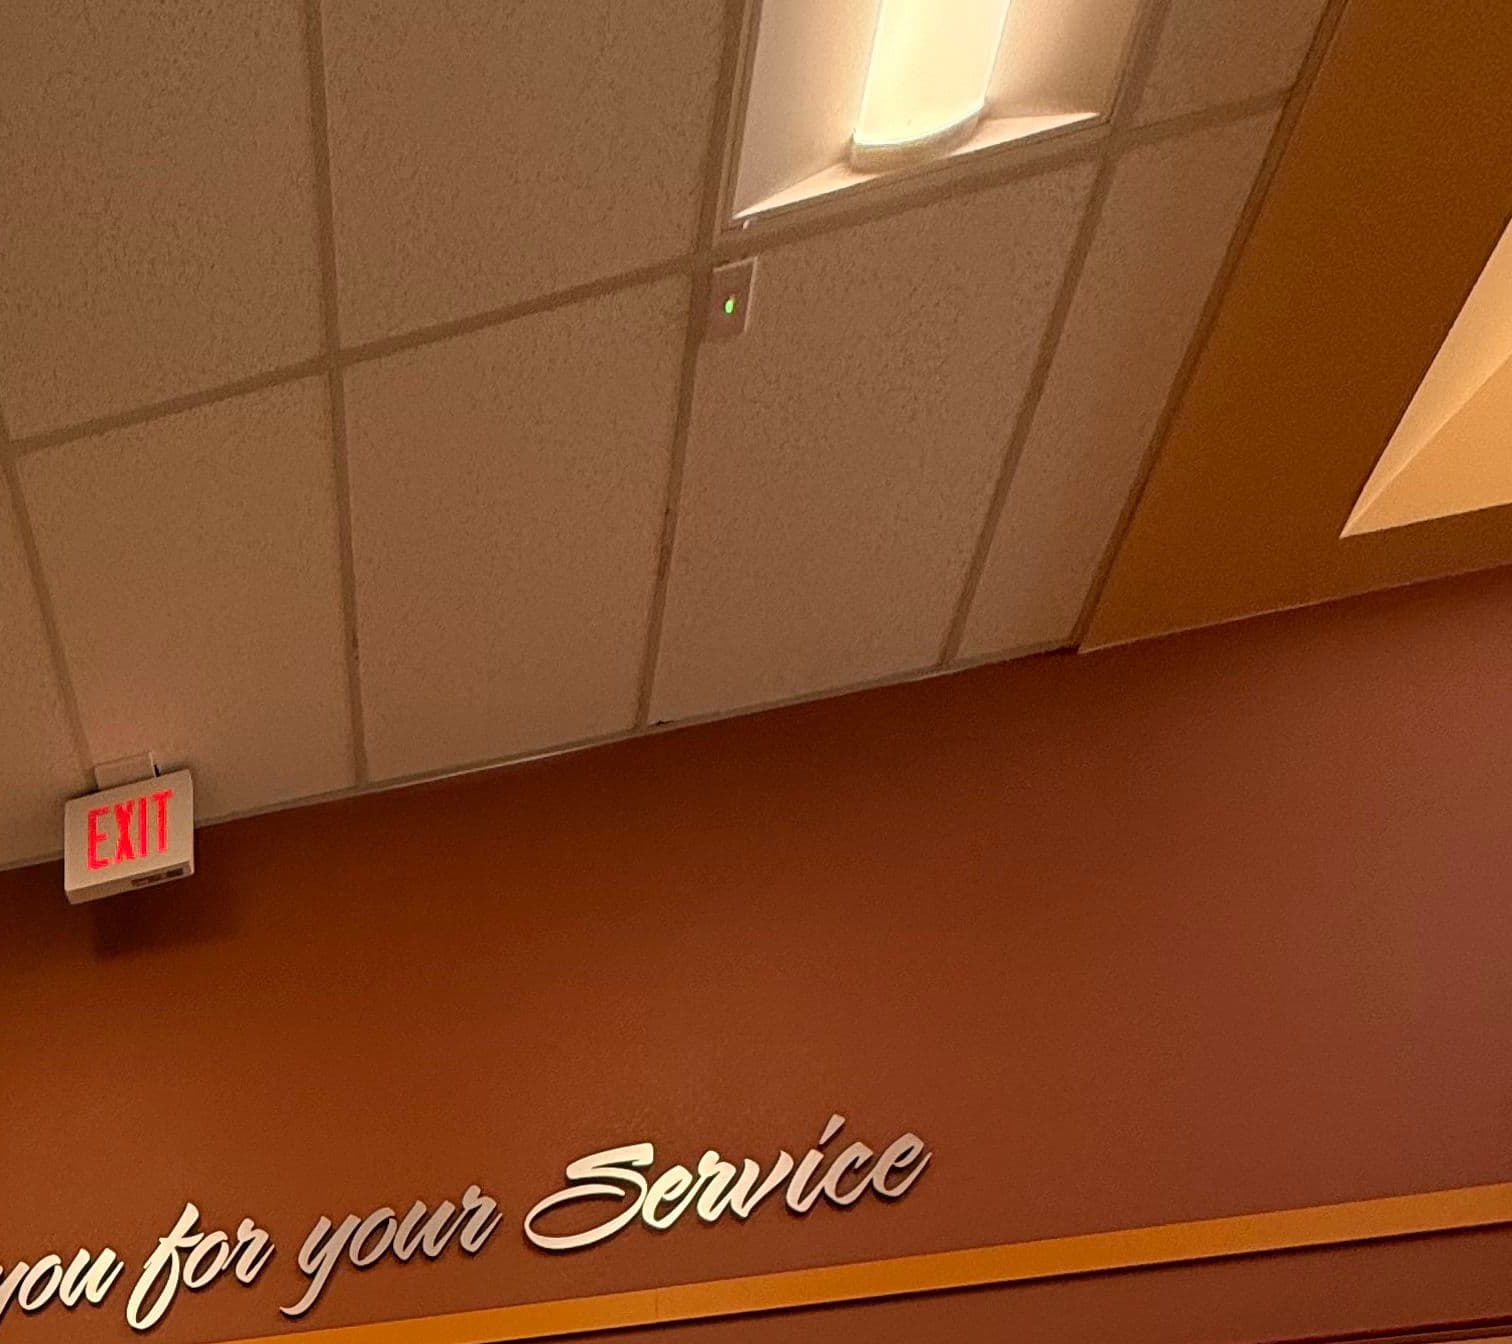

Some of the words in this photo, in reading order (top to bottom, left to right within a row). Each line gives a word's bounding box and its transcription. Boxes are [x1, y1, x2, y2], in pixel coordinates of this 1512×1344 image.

[87, 788, 174, 870] EXIT
[126, 1202, 276, 1330] for
[279, 1185, 503, 1316] your
[524, 1113, 933, 1250] Service
